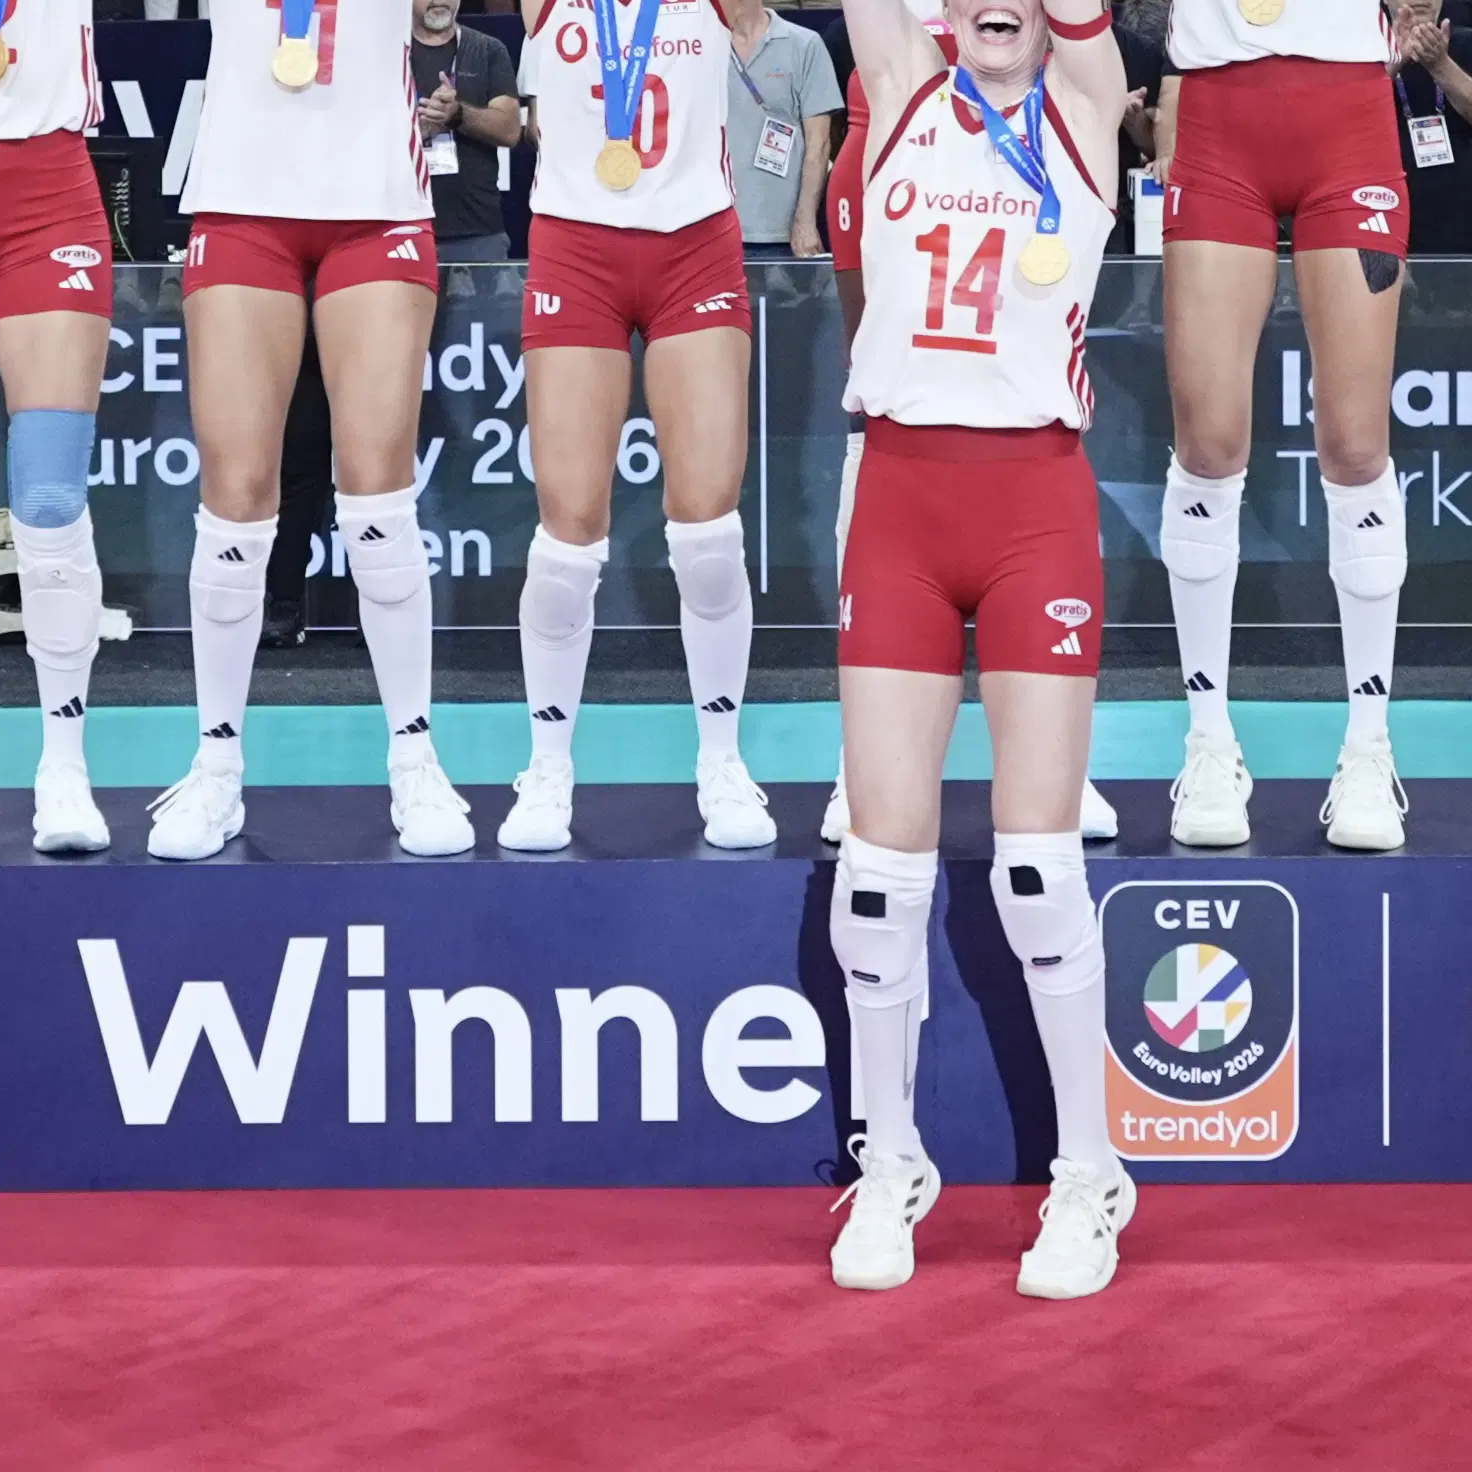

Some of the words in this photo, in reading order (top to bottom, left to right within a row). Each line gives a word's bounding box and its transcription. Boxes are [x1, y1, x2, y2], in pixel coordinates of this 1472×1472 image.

[924, 189, 1037, 217] vodafon
[1169, 186, 1182, 216] 7
[1359, 190, 1396, 203] gratis
[838, 197, 851, 232] 8
[57, 248, 97, 261] gratis
[189, 233, 206, 268] 11
[914, 223, 1005, 336] 14
[1053, 603, 1088, 617] gratis
[1154, 899, 1241, 930] CEV
[77, 925, 873, 1126] Winne
[1132, 1041, 1223, 1086] EuroVolley
[1223, 1041, 1265, 1078] 2026
[1120, 1110, 1278, 1148] trendyol
